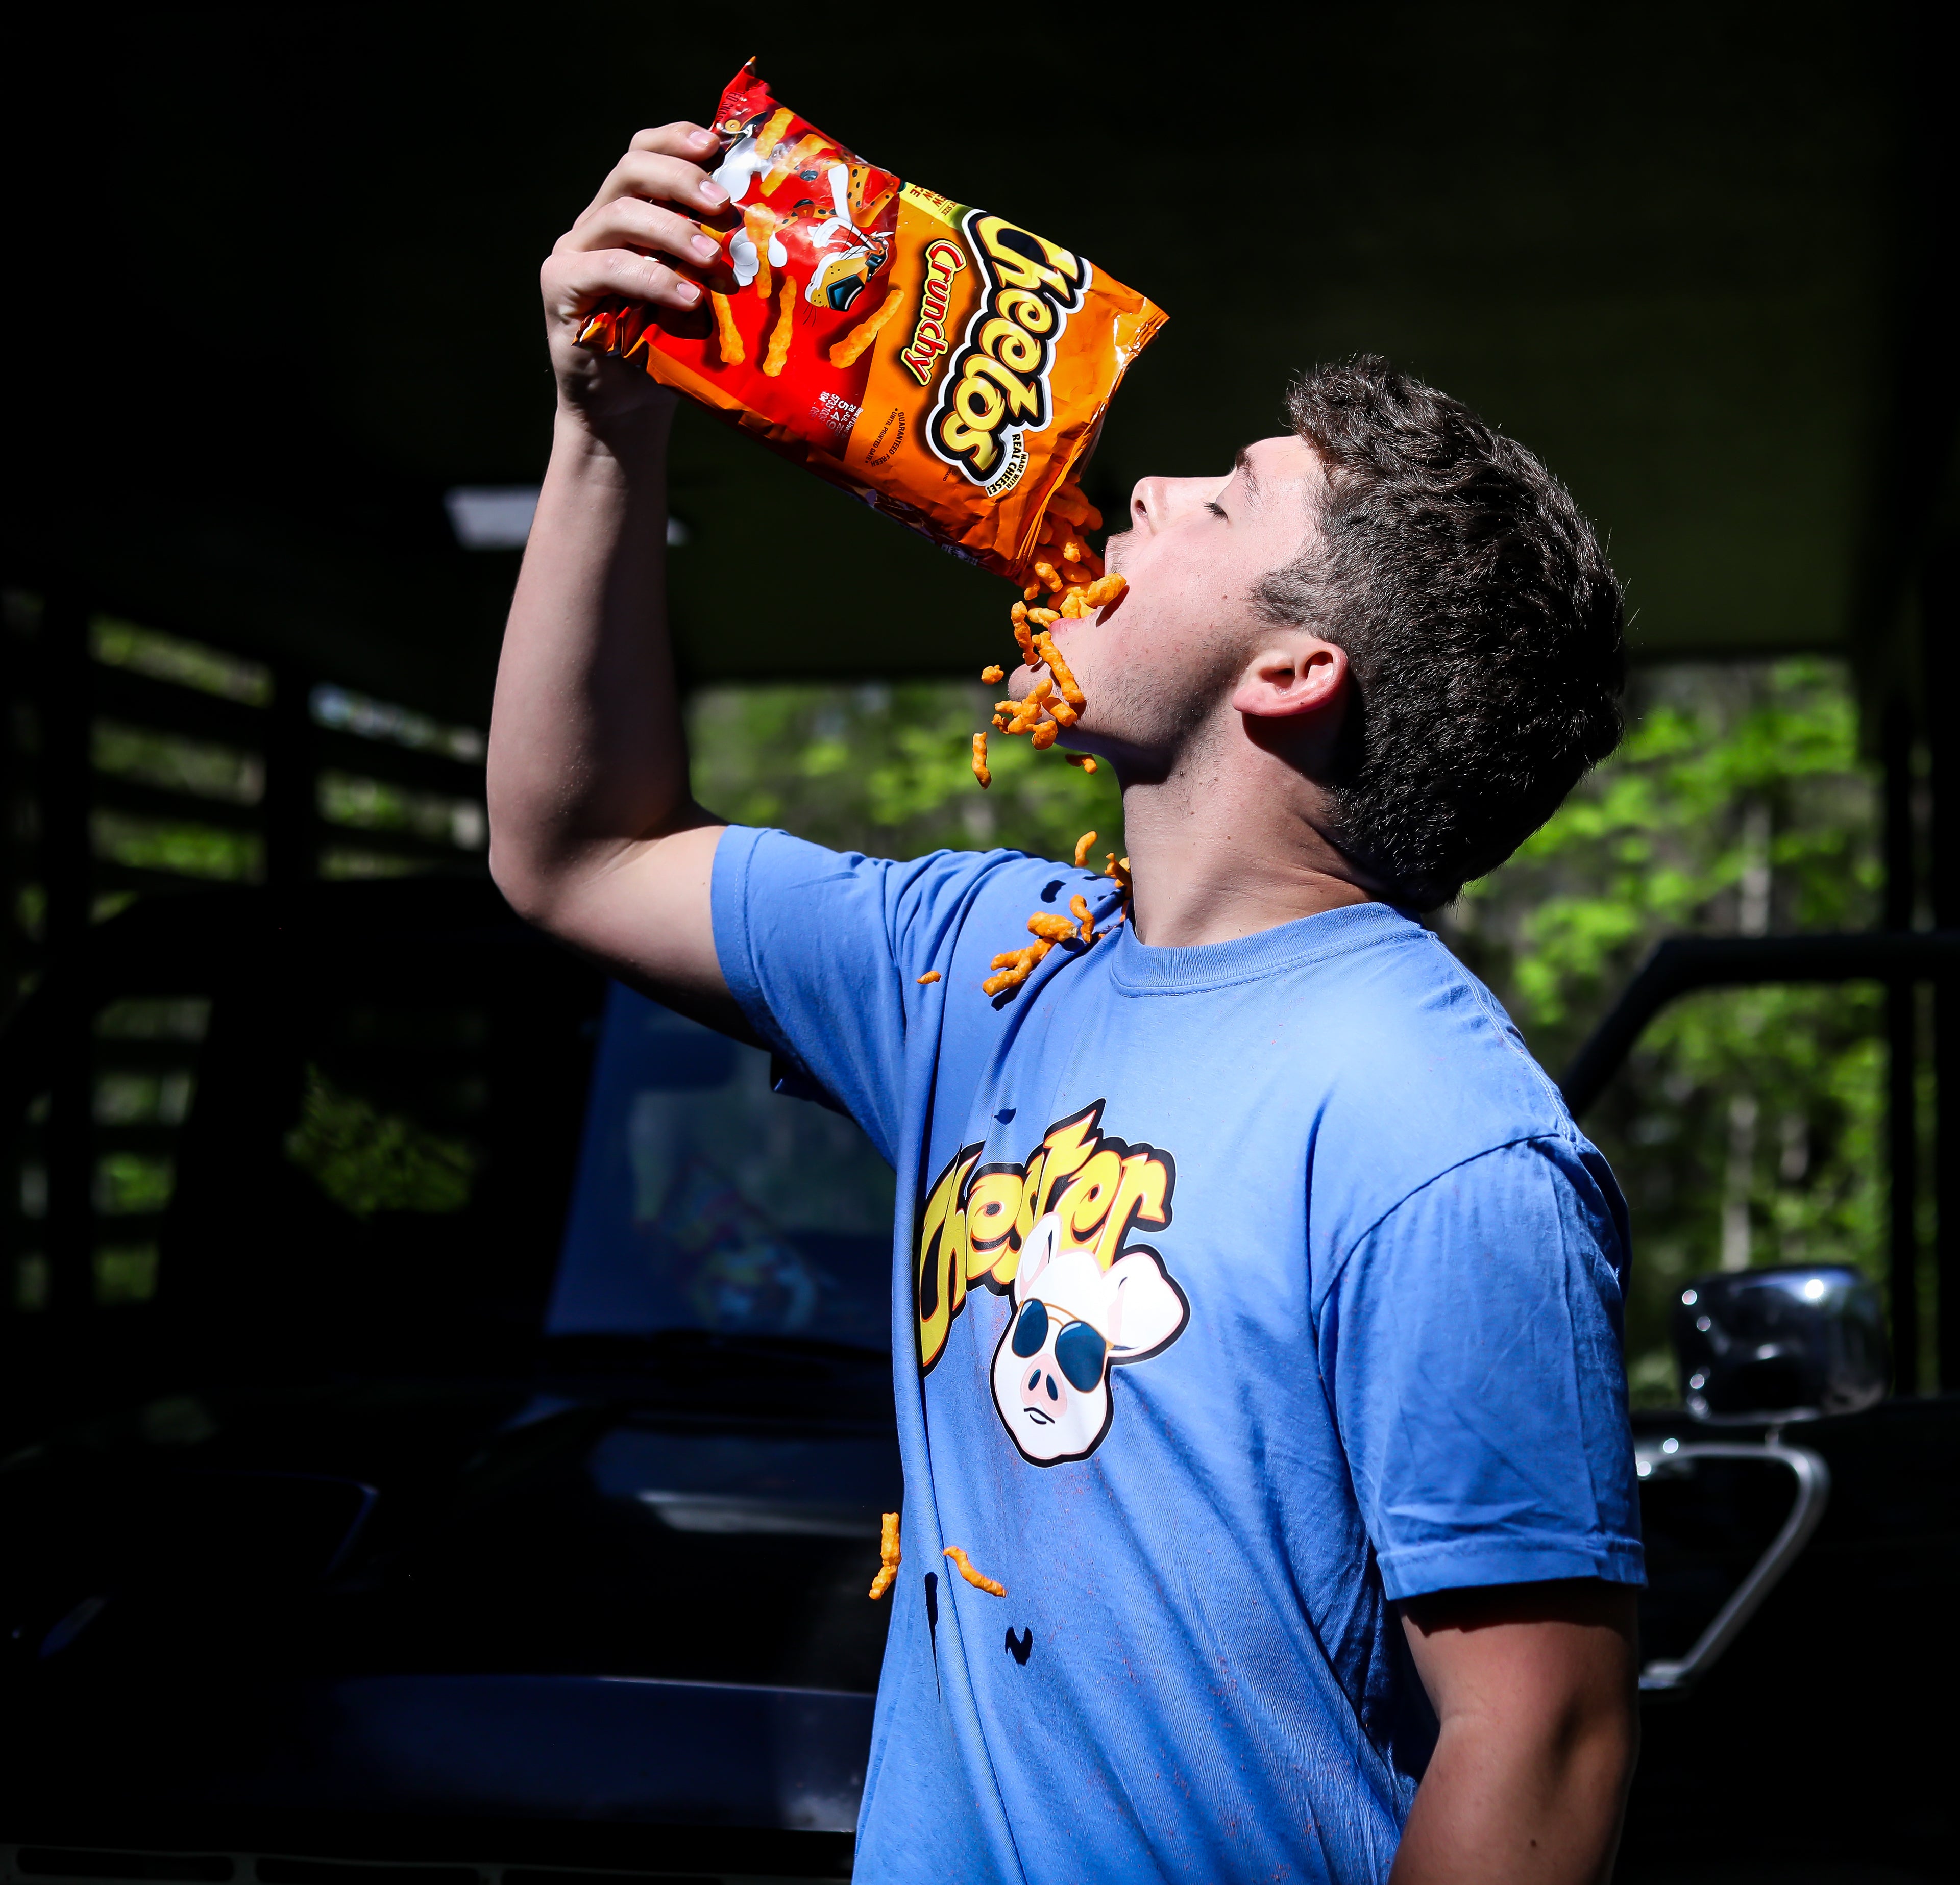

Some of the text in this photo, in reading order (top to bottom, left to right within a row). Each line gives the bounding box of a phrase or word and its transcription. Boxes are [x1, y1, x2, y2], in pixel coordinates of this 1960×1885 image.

[903, 240, 965, 383] Crunchy
[939, 213, 1080, 474] Cheetos
[826, 400, 849, 429] 5.49
[840, 412, 851, 421] JUL
[848, 404, 856, 412] 28
[866, 411, 897, 461] UNTIL PRINTED DATE
[870, 412, 905, 467] GUARANTEED FRESH
[987, 433, 1022, 495] REAL CHEESE!
[1006, 454, 1027, 489] MADE WITH
